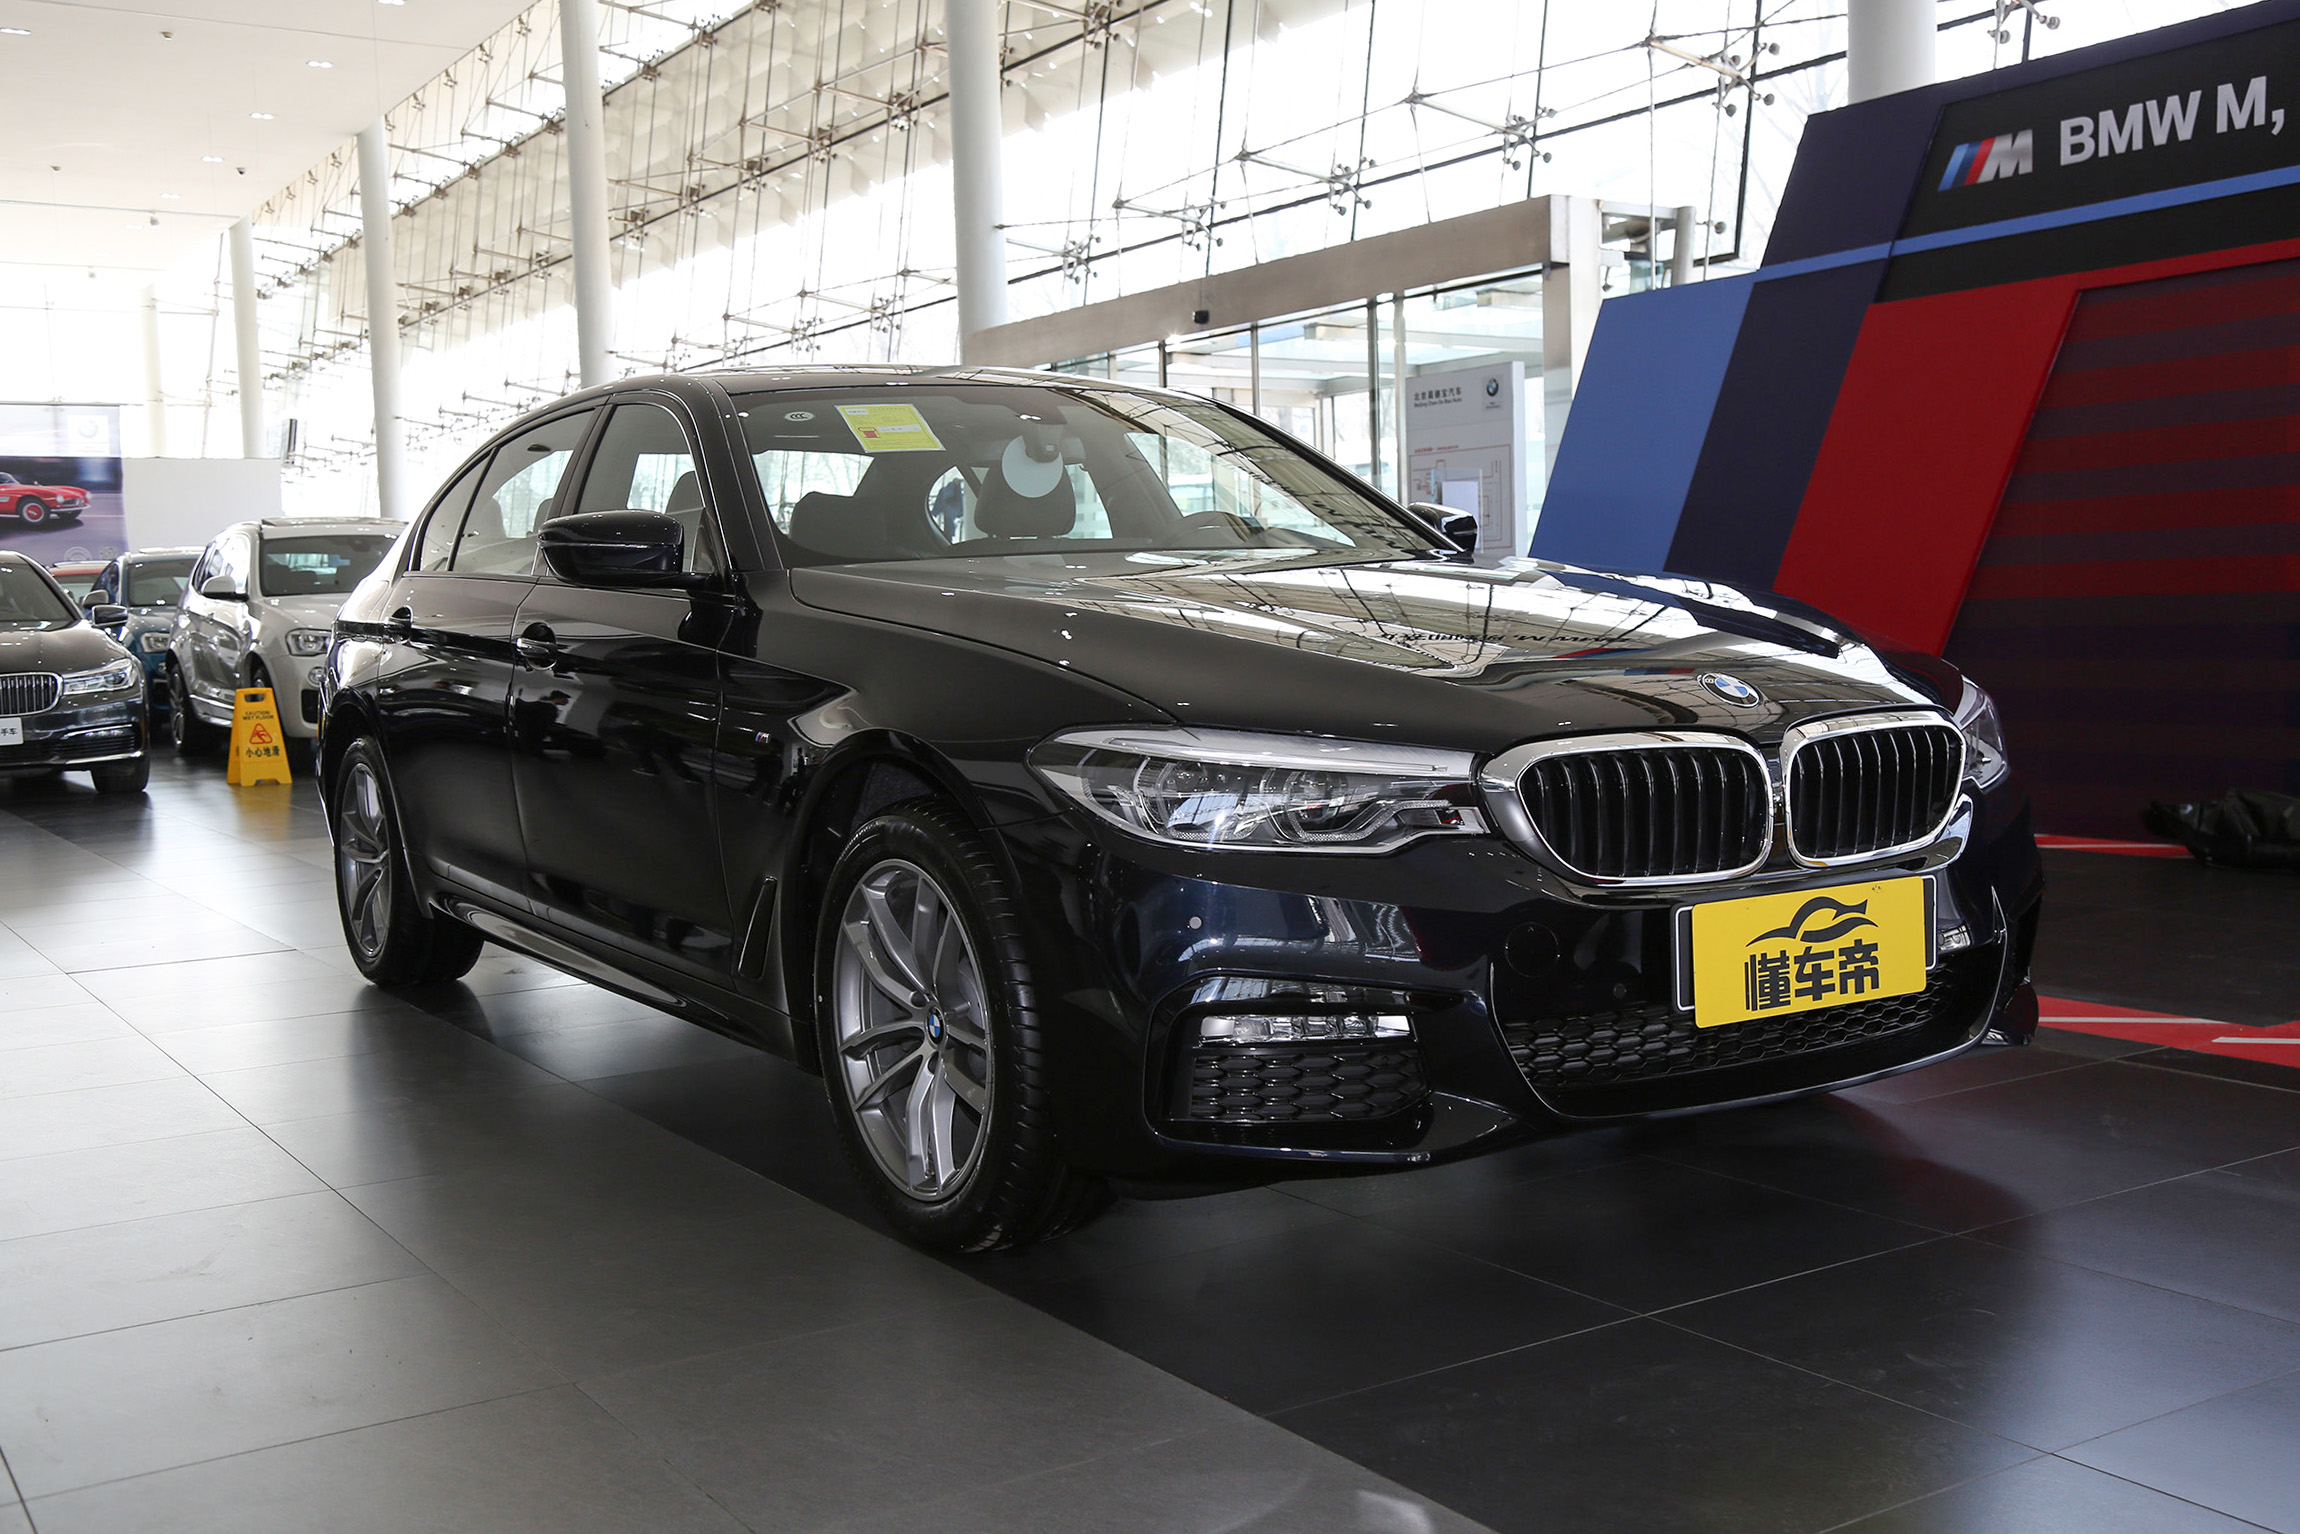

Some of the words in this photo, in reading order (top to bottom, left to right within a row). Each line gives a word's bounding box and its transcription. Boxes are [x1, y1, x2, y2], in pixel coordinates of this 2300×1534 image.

[2060, 91, 2202, 166] BMW
[2215, 76, 2286, 136] M,
[1744, 938, 1880, 1012] 懂车帝
